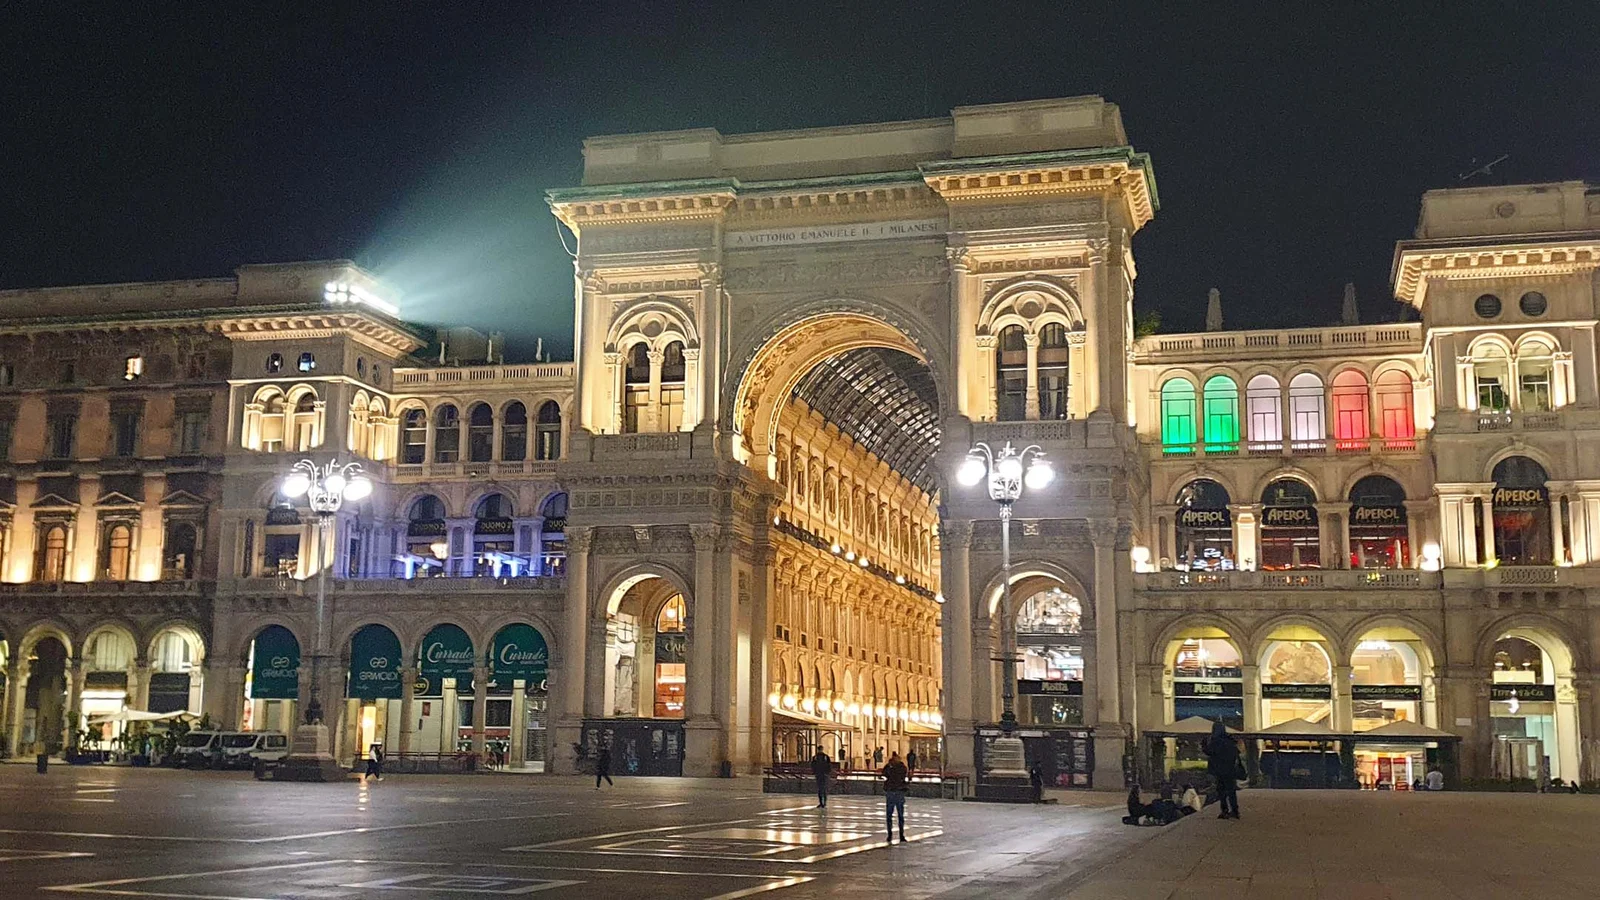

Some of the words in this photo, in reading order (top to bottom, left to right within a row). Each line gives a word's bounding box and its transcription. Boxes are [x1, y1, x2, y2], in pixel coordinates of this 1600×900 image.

[737, 235, 744, 243] A
[749, 232, 796, 243] VITTORIO
[801, 228, 856, 240] EMANUELE
[889, 222, 939, 234] MILANESI
[1495, 487, 1544, 502] APEROL
[1182, 510, 1225, 522] APEROL
[1268, 508, 1311, 521] APEROL
[1355, 506, 1400, 520] APEROL
